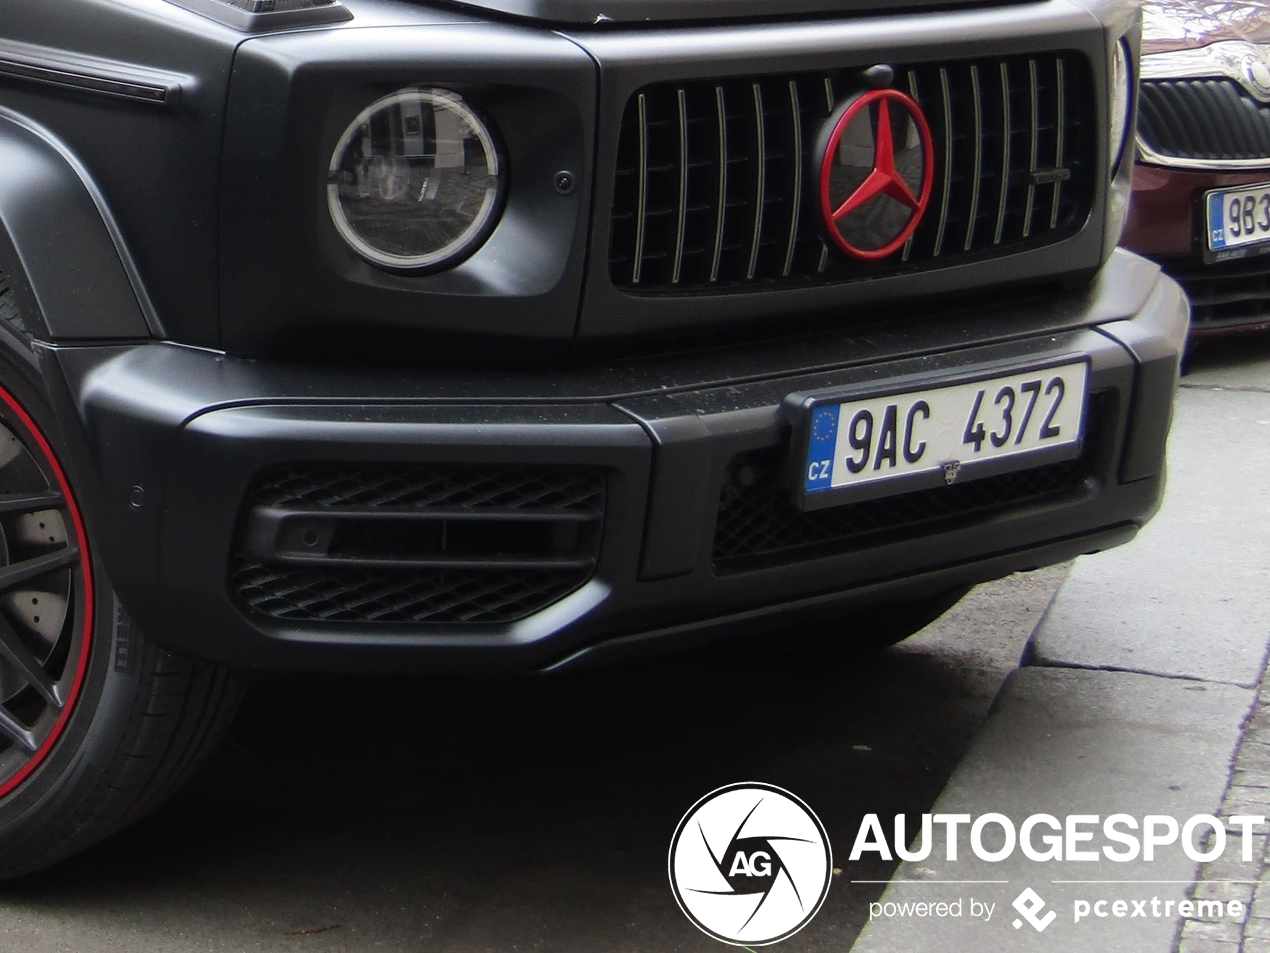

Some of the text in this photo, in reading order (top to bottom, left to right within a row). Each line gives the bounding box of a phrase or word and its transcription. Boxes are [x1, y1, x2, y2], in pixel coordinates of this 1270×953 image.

[1212, 228, 1224, 241] CZ
[845, 376, 1065, 474] 9AC 4372
[808, 459, 830, 481] CZ
